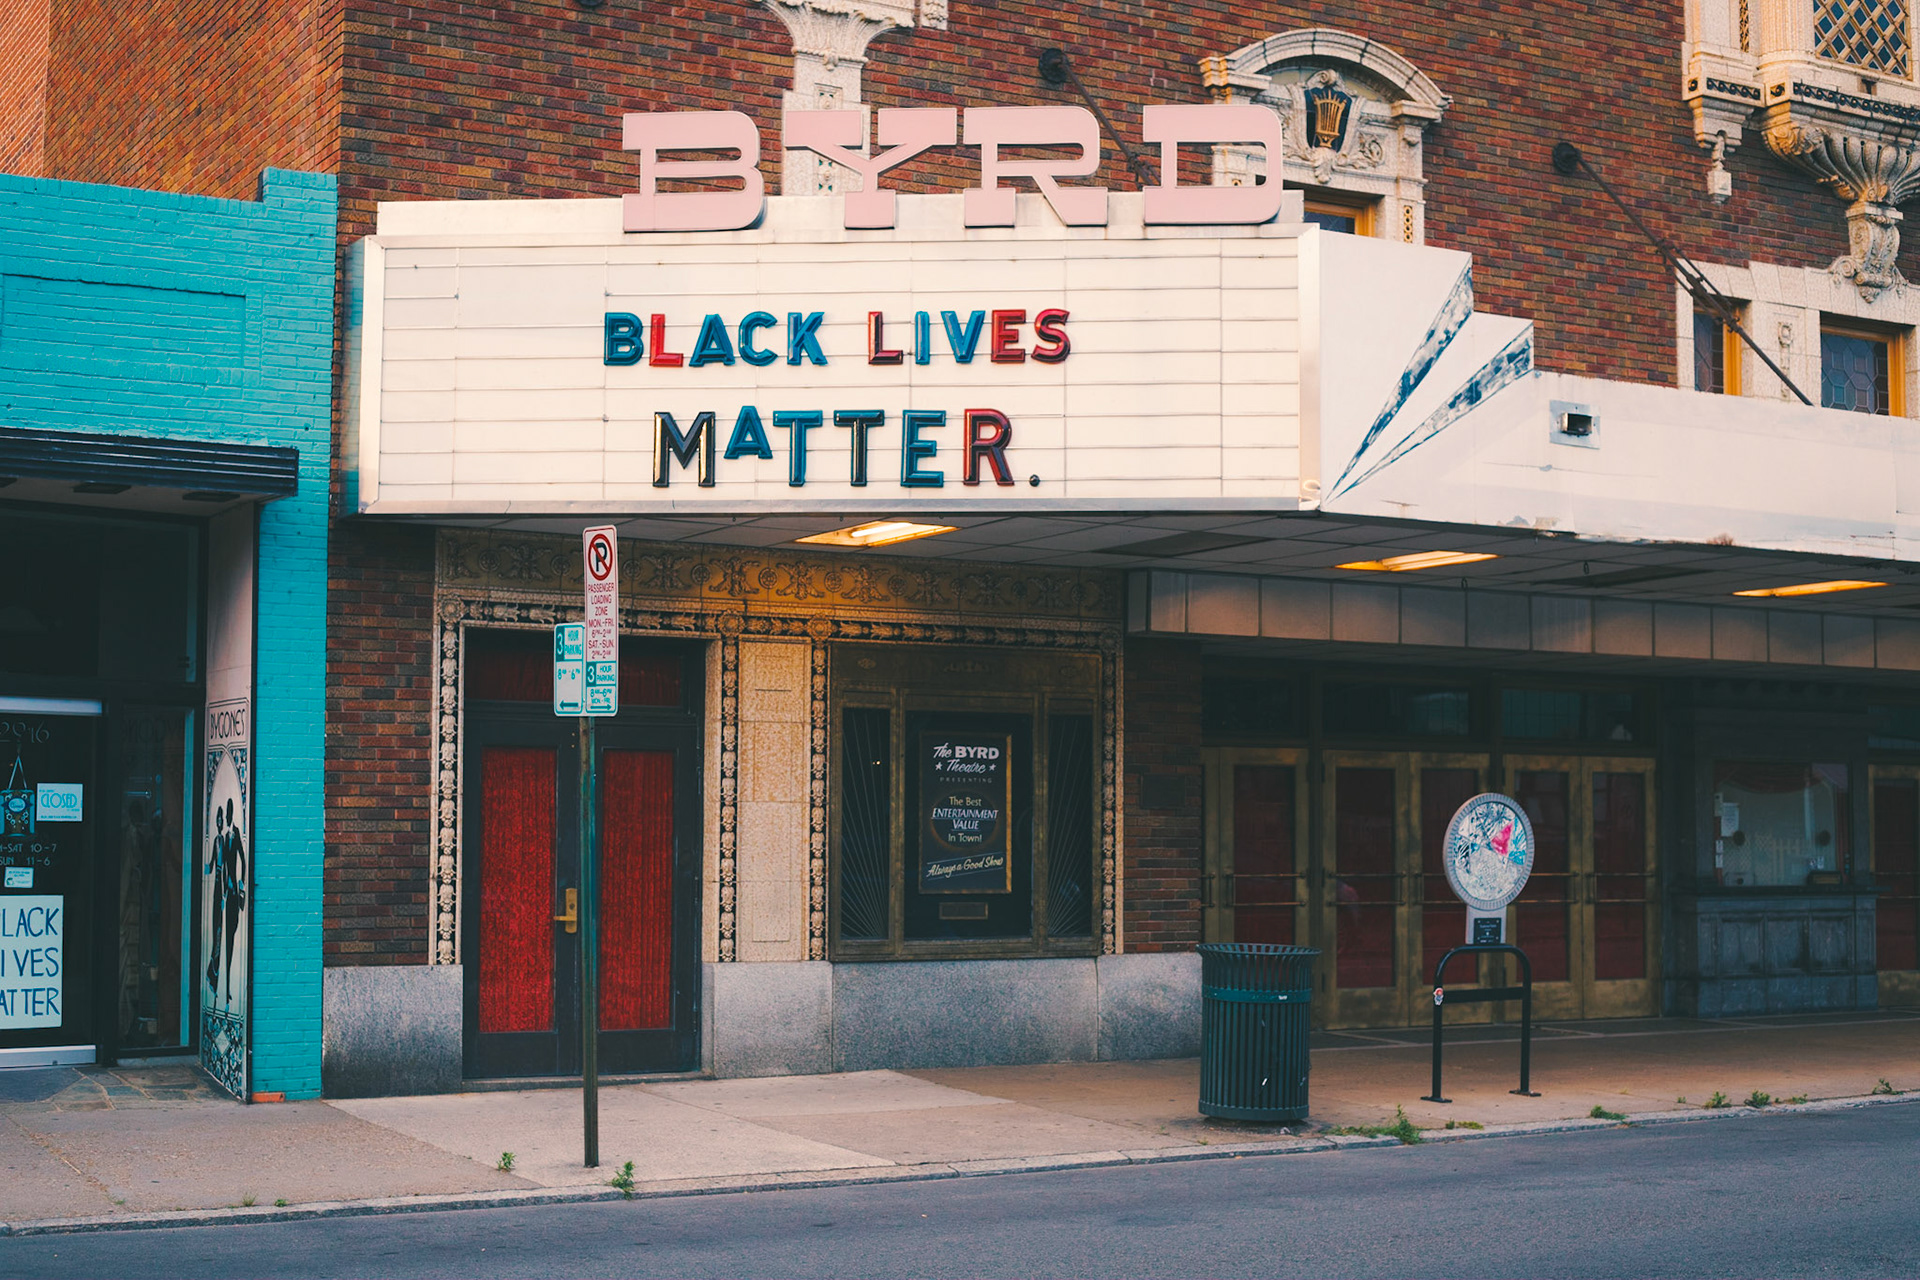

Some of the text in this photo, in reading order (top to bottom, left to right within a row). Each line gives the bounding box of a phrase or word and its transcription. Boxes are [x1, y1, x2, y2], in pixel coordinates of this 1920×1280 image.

[623, 104, 1285, 231] BYRD
[604, 308, 1071, 367] BLACK LIVES
[652, 406, 1041, 488] MATTER.
[588, 582, 614, 593] PASSENGER
[591, 594, 612, 605] LOADING
[595, 606, 608, 616] ZONE
[557, 633, 563, 655] 3
[565, 644, 582, 655] PARKING
[588, 665, 612, 683] 3 HOUR
[597, 674, 615, 682] PARKING
[210, 709, 246, 740] BYGONES
[933, 742, 1000, 760] The BYRD
[946, 759, 986, 774] Theatre
[940, 776, 993, 784] PRESENTING
[41, 792, 78, 809] CLOSED
[949, 795, 982, 807] The Best
[932, 807, 999, 819] ENTERTAINMENT
[952, 819, 980, 830] VALUE
[948, 833, 983, 843] In Town!
[926, 864, 956, 879] Always
[963, 858, 986, 871] Good
[984, 855, 1004, 868] Show
[0, 906, 60, 938] LACK
[0, 946, 60, 978] IVES
[0, 987, 61, 1017] ATTER
